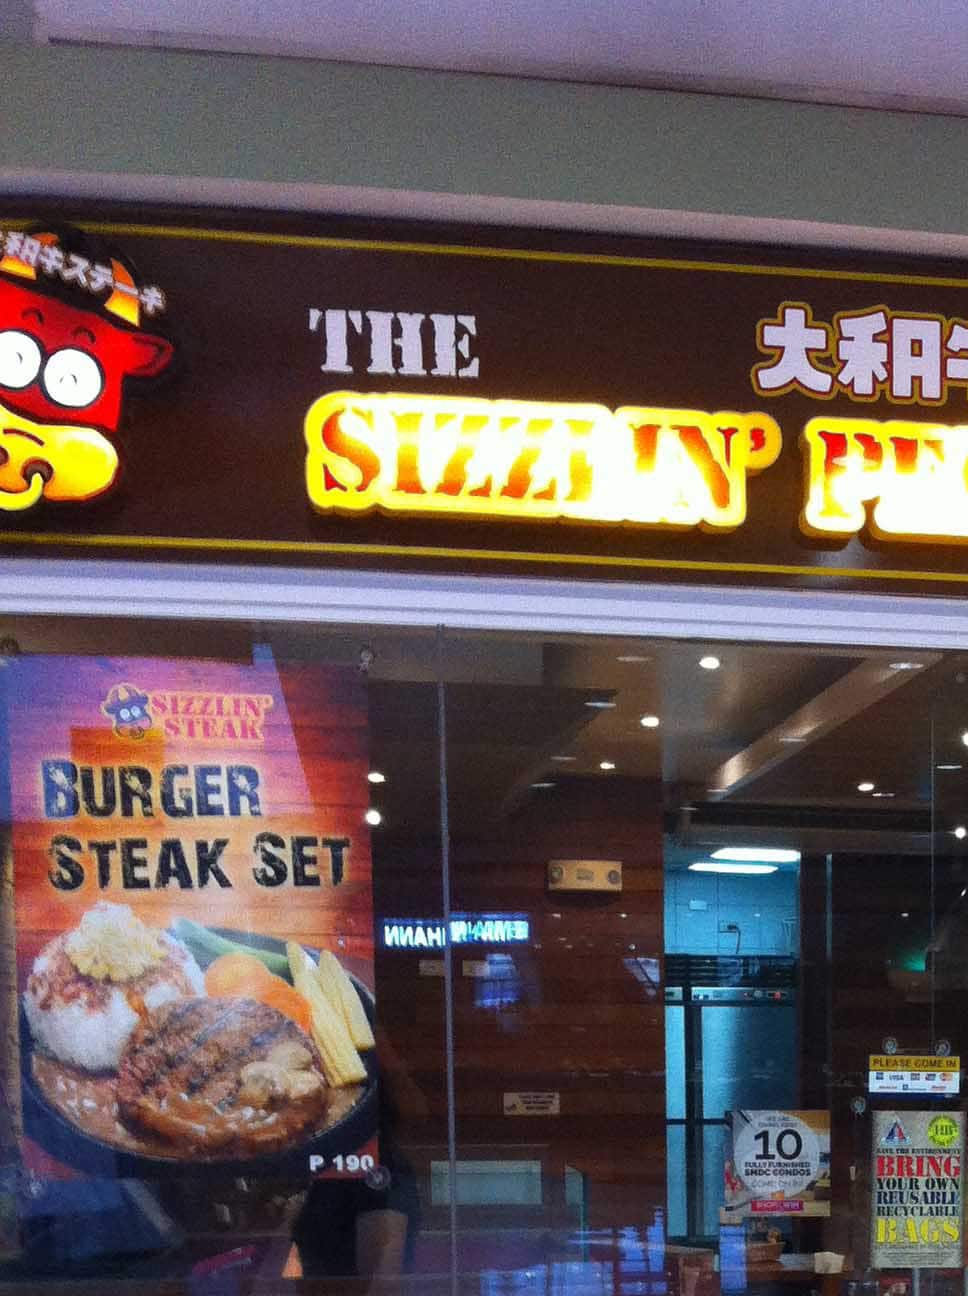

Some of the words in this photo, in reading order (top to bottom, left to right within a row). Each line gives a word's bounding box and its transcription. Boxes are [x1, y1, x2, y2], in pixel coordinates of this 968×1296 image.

[0, 231, 165, 315] 和牛ステーキ
[309, 308, 480, 379] THE
[165, 718, 262, 739] STEAK
[41, 759, 263, 819] BURGER
[48, 834, 233, 892] STEAK
[252, 832, 351, 888] SET
[873, 1058, 911, 1068] PLEASE
[914, 1058, 944, 1068] COME
[946, 1058, 957, 1068] IN
[753, 1128, 803, 1160] 10
[309, 1154, 325, 1172] P
[332, 1154, 375, 1172] 190
[773, 1168, 811, 1177] CONDOS
[876, 1155, 961, 1177] BRING
[876, 1177, 920, 1190] YOUR
[925, 1177, 961, 1190] OWN
[876, 1191, 960, 1205] REUSABLE
[876, 1206, 960, 1217] RECYCLABLE
[876, 1217, 960, 1245] BAGS
